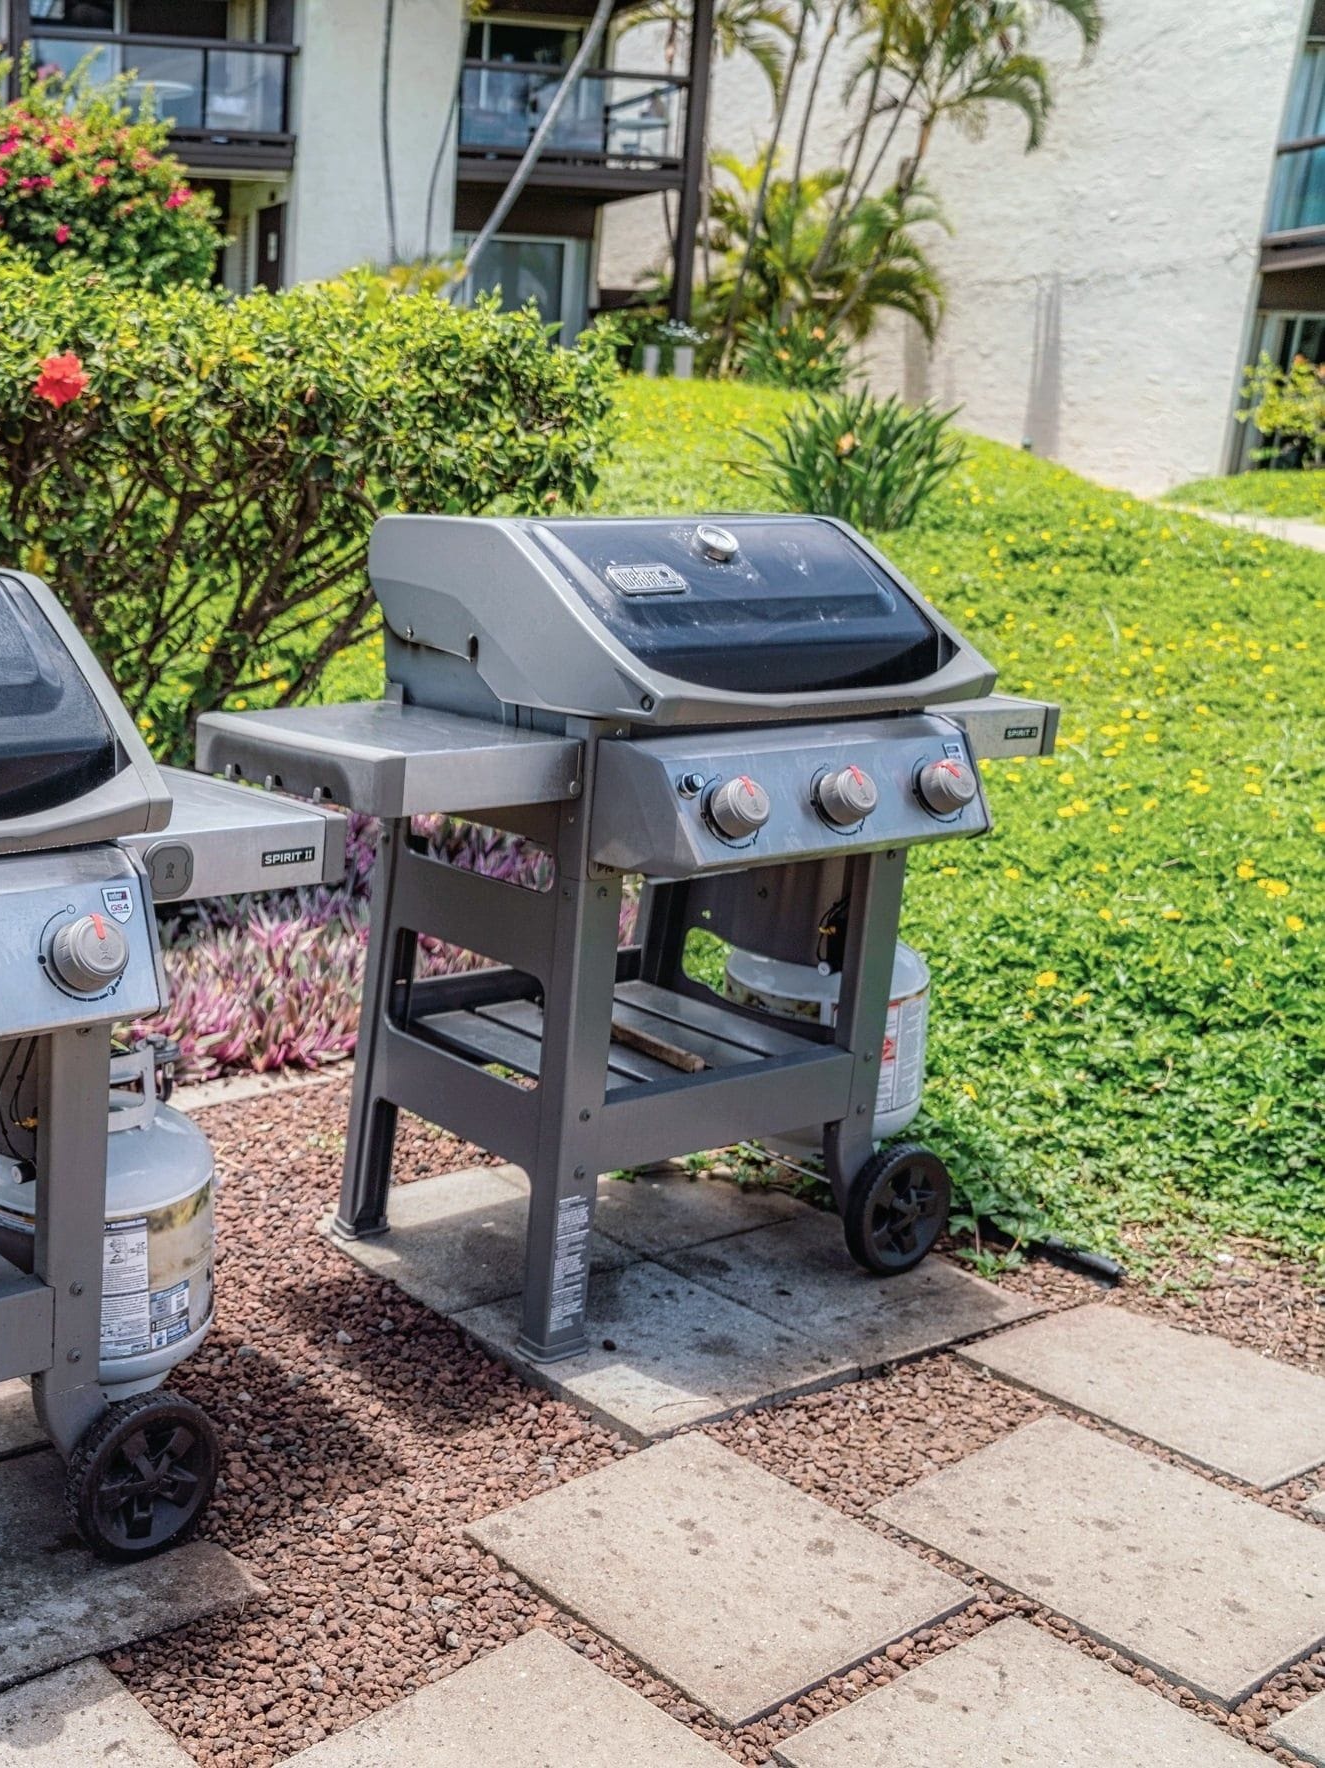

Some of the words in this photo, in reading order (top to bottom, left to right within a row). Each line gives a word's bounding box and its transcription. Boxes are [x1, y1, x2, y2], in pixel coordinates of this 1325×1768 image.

[1007, 729, 1030, 738] SPIRIT
[264, 851, 302, 864] SPIRIT
[304, 850, 312, 860] II
